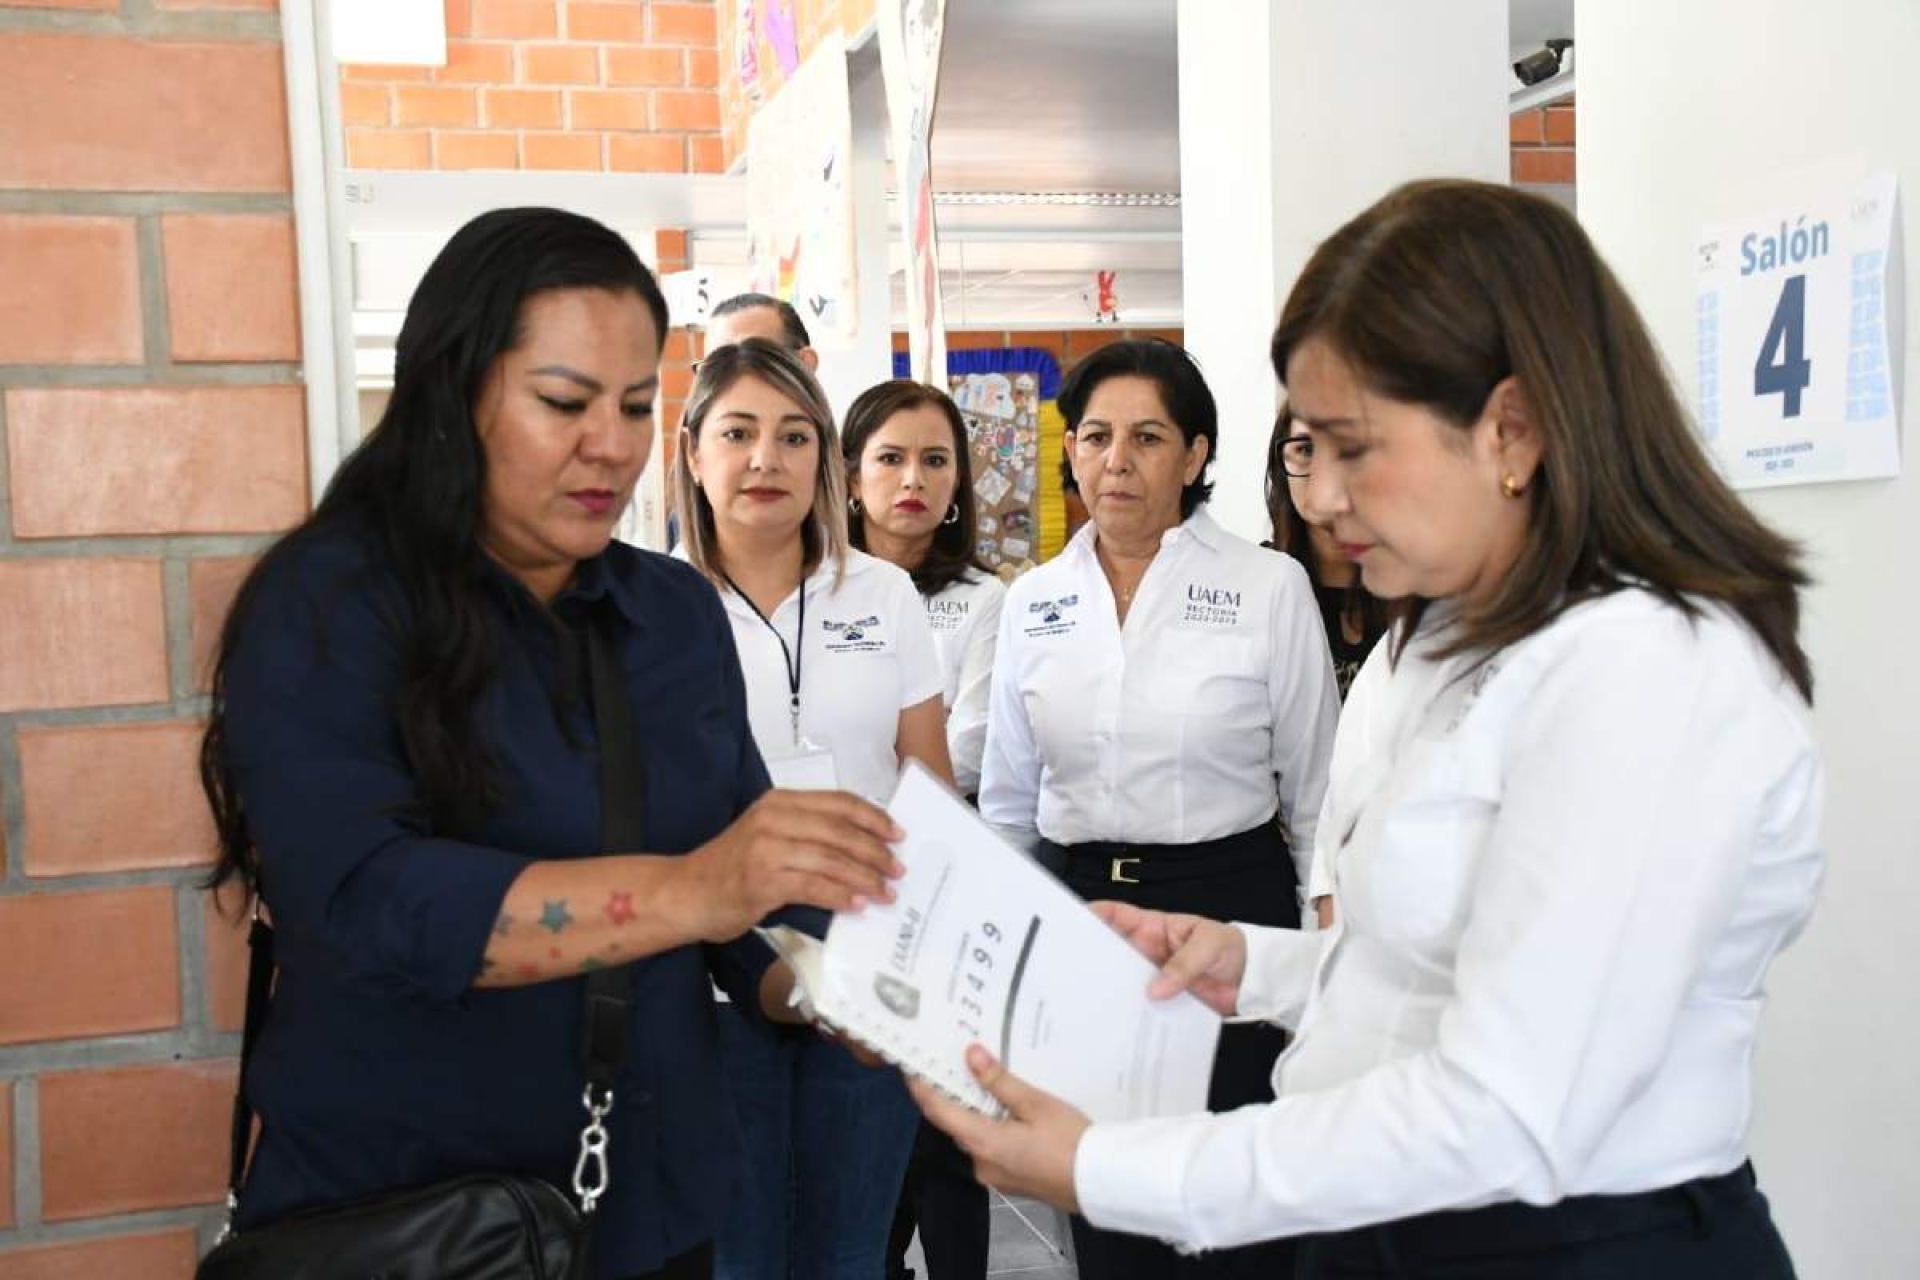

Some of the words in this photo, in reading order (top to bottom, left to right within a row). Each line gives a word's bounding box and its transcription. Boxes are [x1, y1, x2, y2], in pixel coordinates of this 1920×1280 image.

[1740, 215, 1829, 276] Salón
[1754, 274, 1811, 418] 4
[927, 601, 969, 614] UAEM
[1188, 583, 1241, 607] UAEM
